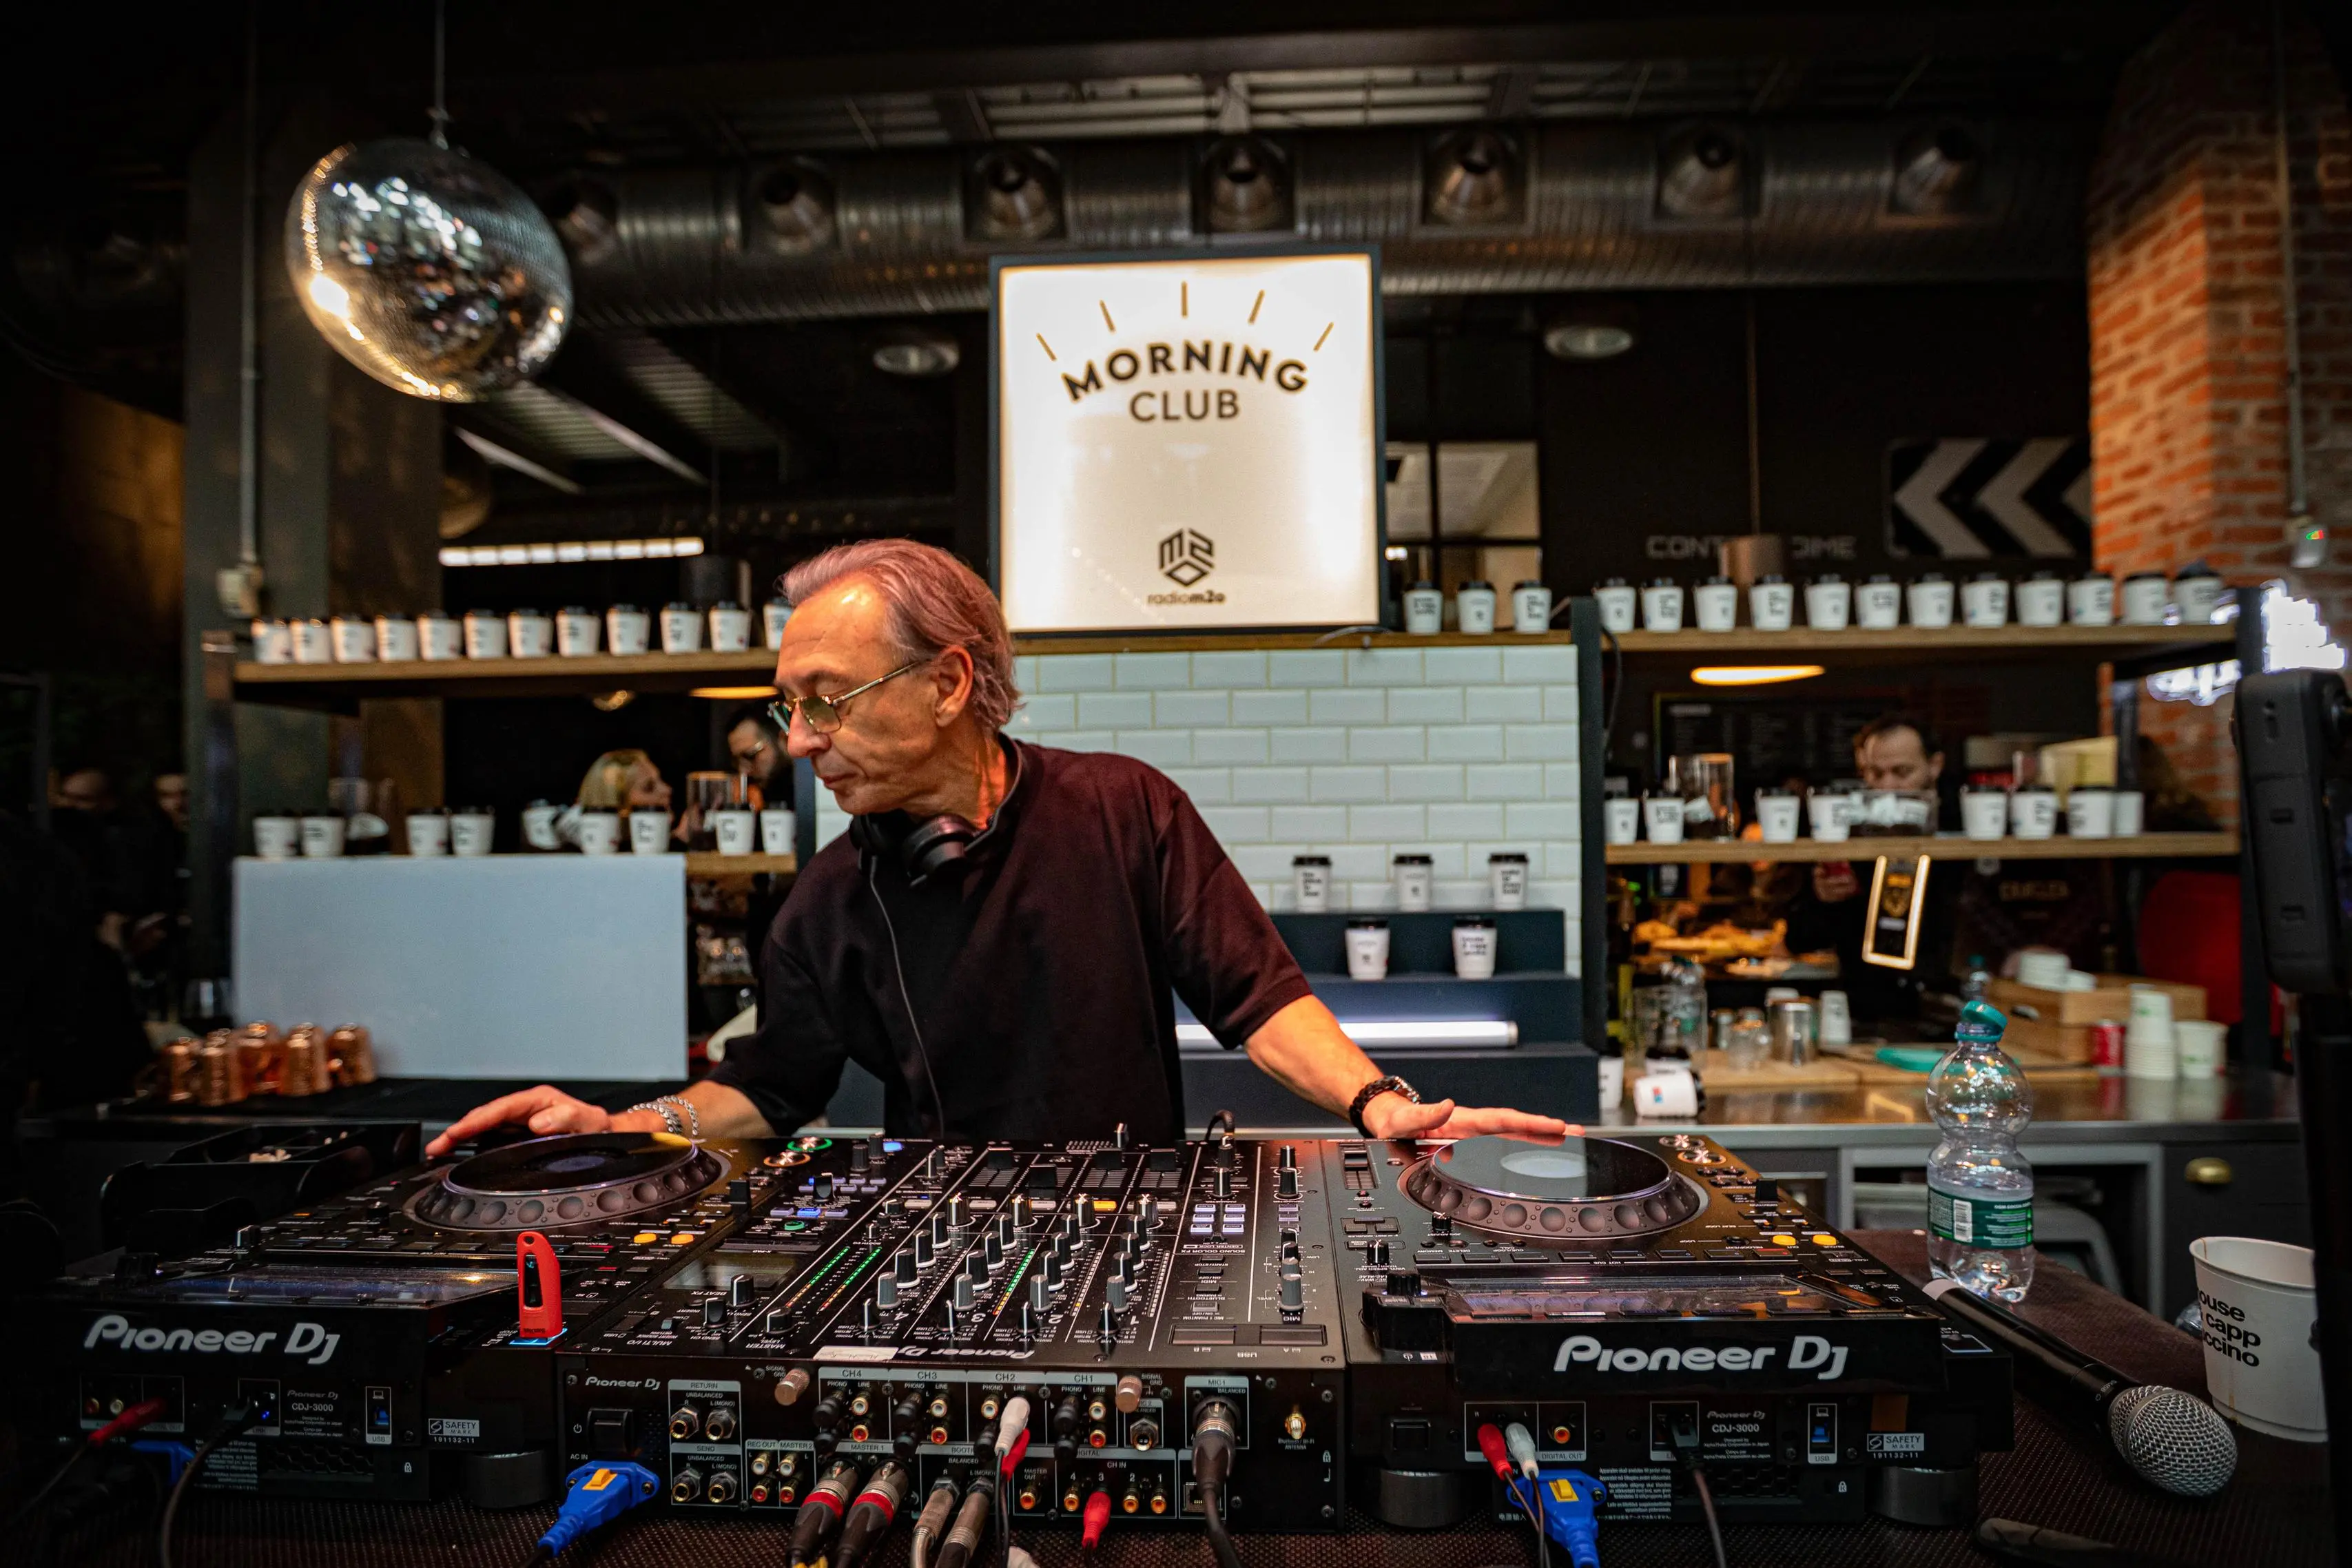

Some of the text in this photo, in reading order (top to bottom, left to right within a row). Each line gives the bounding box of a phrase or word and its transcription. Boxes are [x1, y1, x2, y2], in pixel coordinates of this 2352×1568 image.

[1060, 339, 1309, 403] MORNING
[1128, 389, 1241, 423] CLUB
[2198, 1290, 2246, 1322] ouse
[894, 1311, 909, 1321] 4
[971, 1312, 986, 1322] 3
[1048, 1314, 1064, 1323] 2
[1131, 1316, 1139, 1325] 1
[83, 1314, 278, 1353] Pioneer
[930, 1348, 1034, 1359] Pioneer
[1554, 1334, 1776, 1372] Pioneer
[2204, 1332, 2260, 1368] ccino
[842, 1369, 862, 1378] CH4
[917, 1372, 938, 1380] CH3
[995, 1373, 1015, 1382] CH2
[585, 1376, 643, 1388] Pioneer
[287, 1389, 327, 1399] Pioneer
[291, 1403, 334, 1412] CDJ-3000
[444, 1421, 477, 1430] SAFETY
[1711, 1423, 1760, 1433] CDJ-3000
[1885, 1435, 1921, 1443] SAFETY
[1129, 1474, 1135, 1482] 2
[1157, 1474, 1162, 1482] 1
